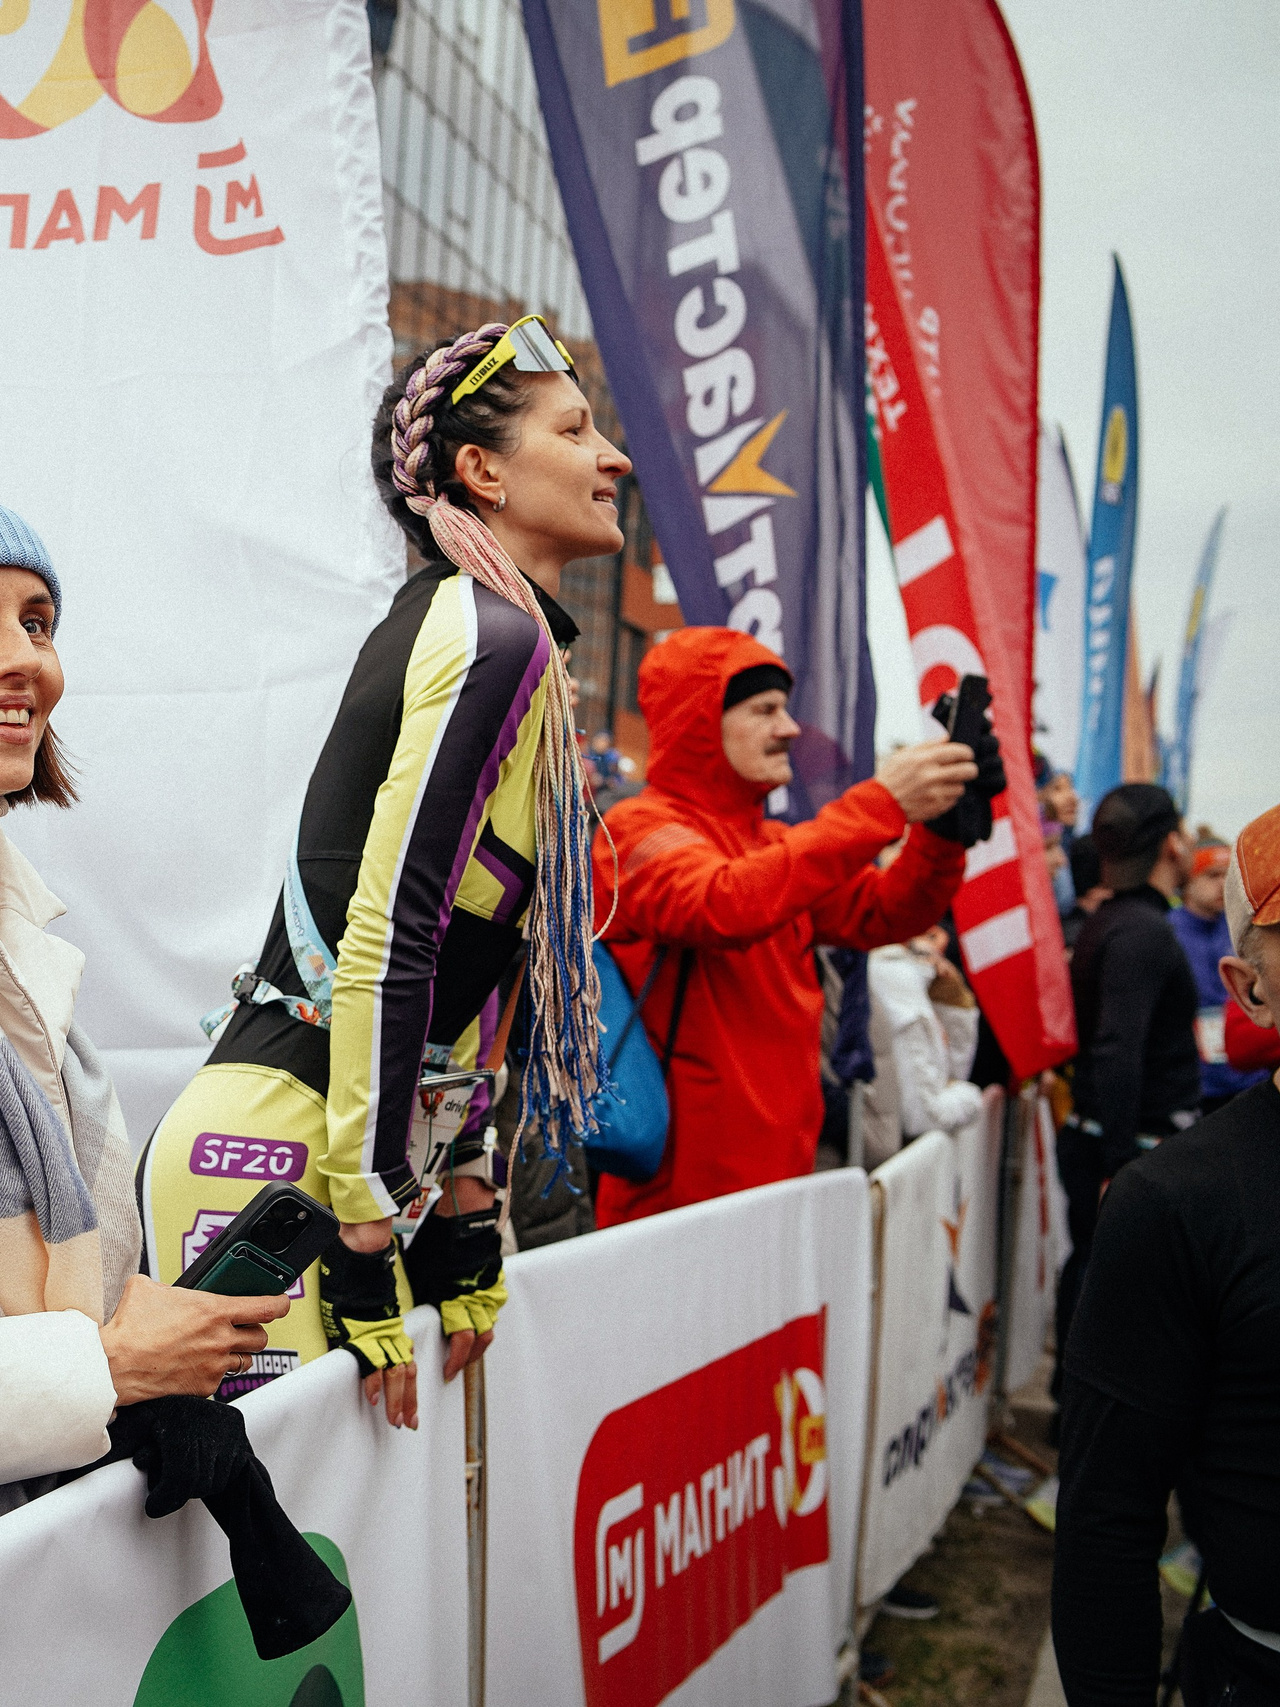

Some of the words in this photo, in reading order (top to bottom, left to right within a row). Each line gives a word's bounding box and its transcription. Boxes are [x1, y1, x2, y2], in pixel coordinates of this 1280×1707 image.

[478, 357, 499, 376] BLIZ
[199, 1138, 294, 1176] SF20
[654, 1433, 771, 1588] МАГНИТ
